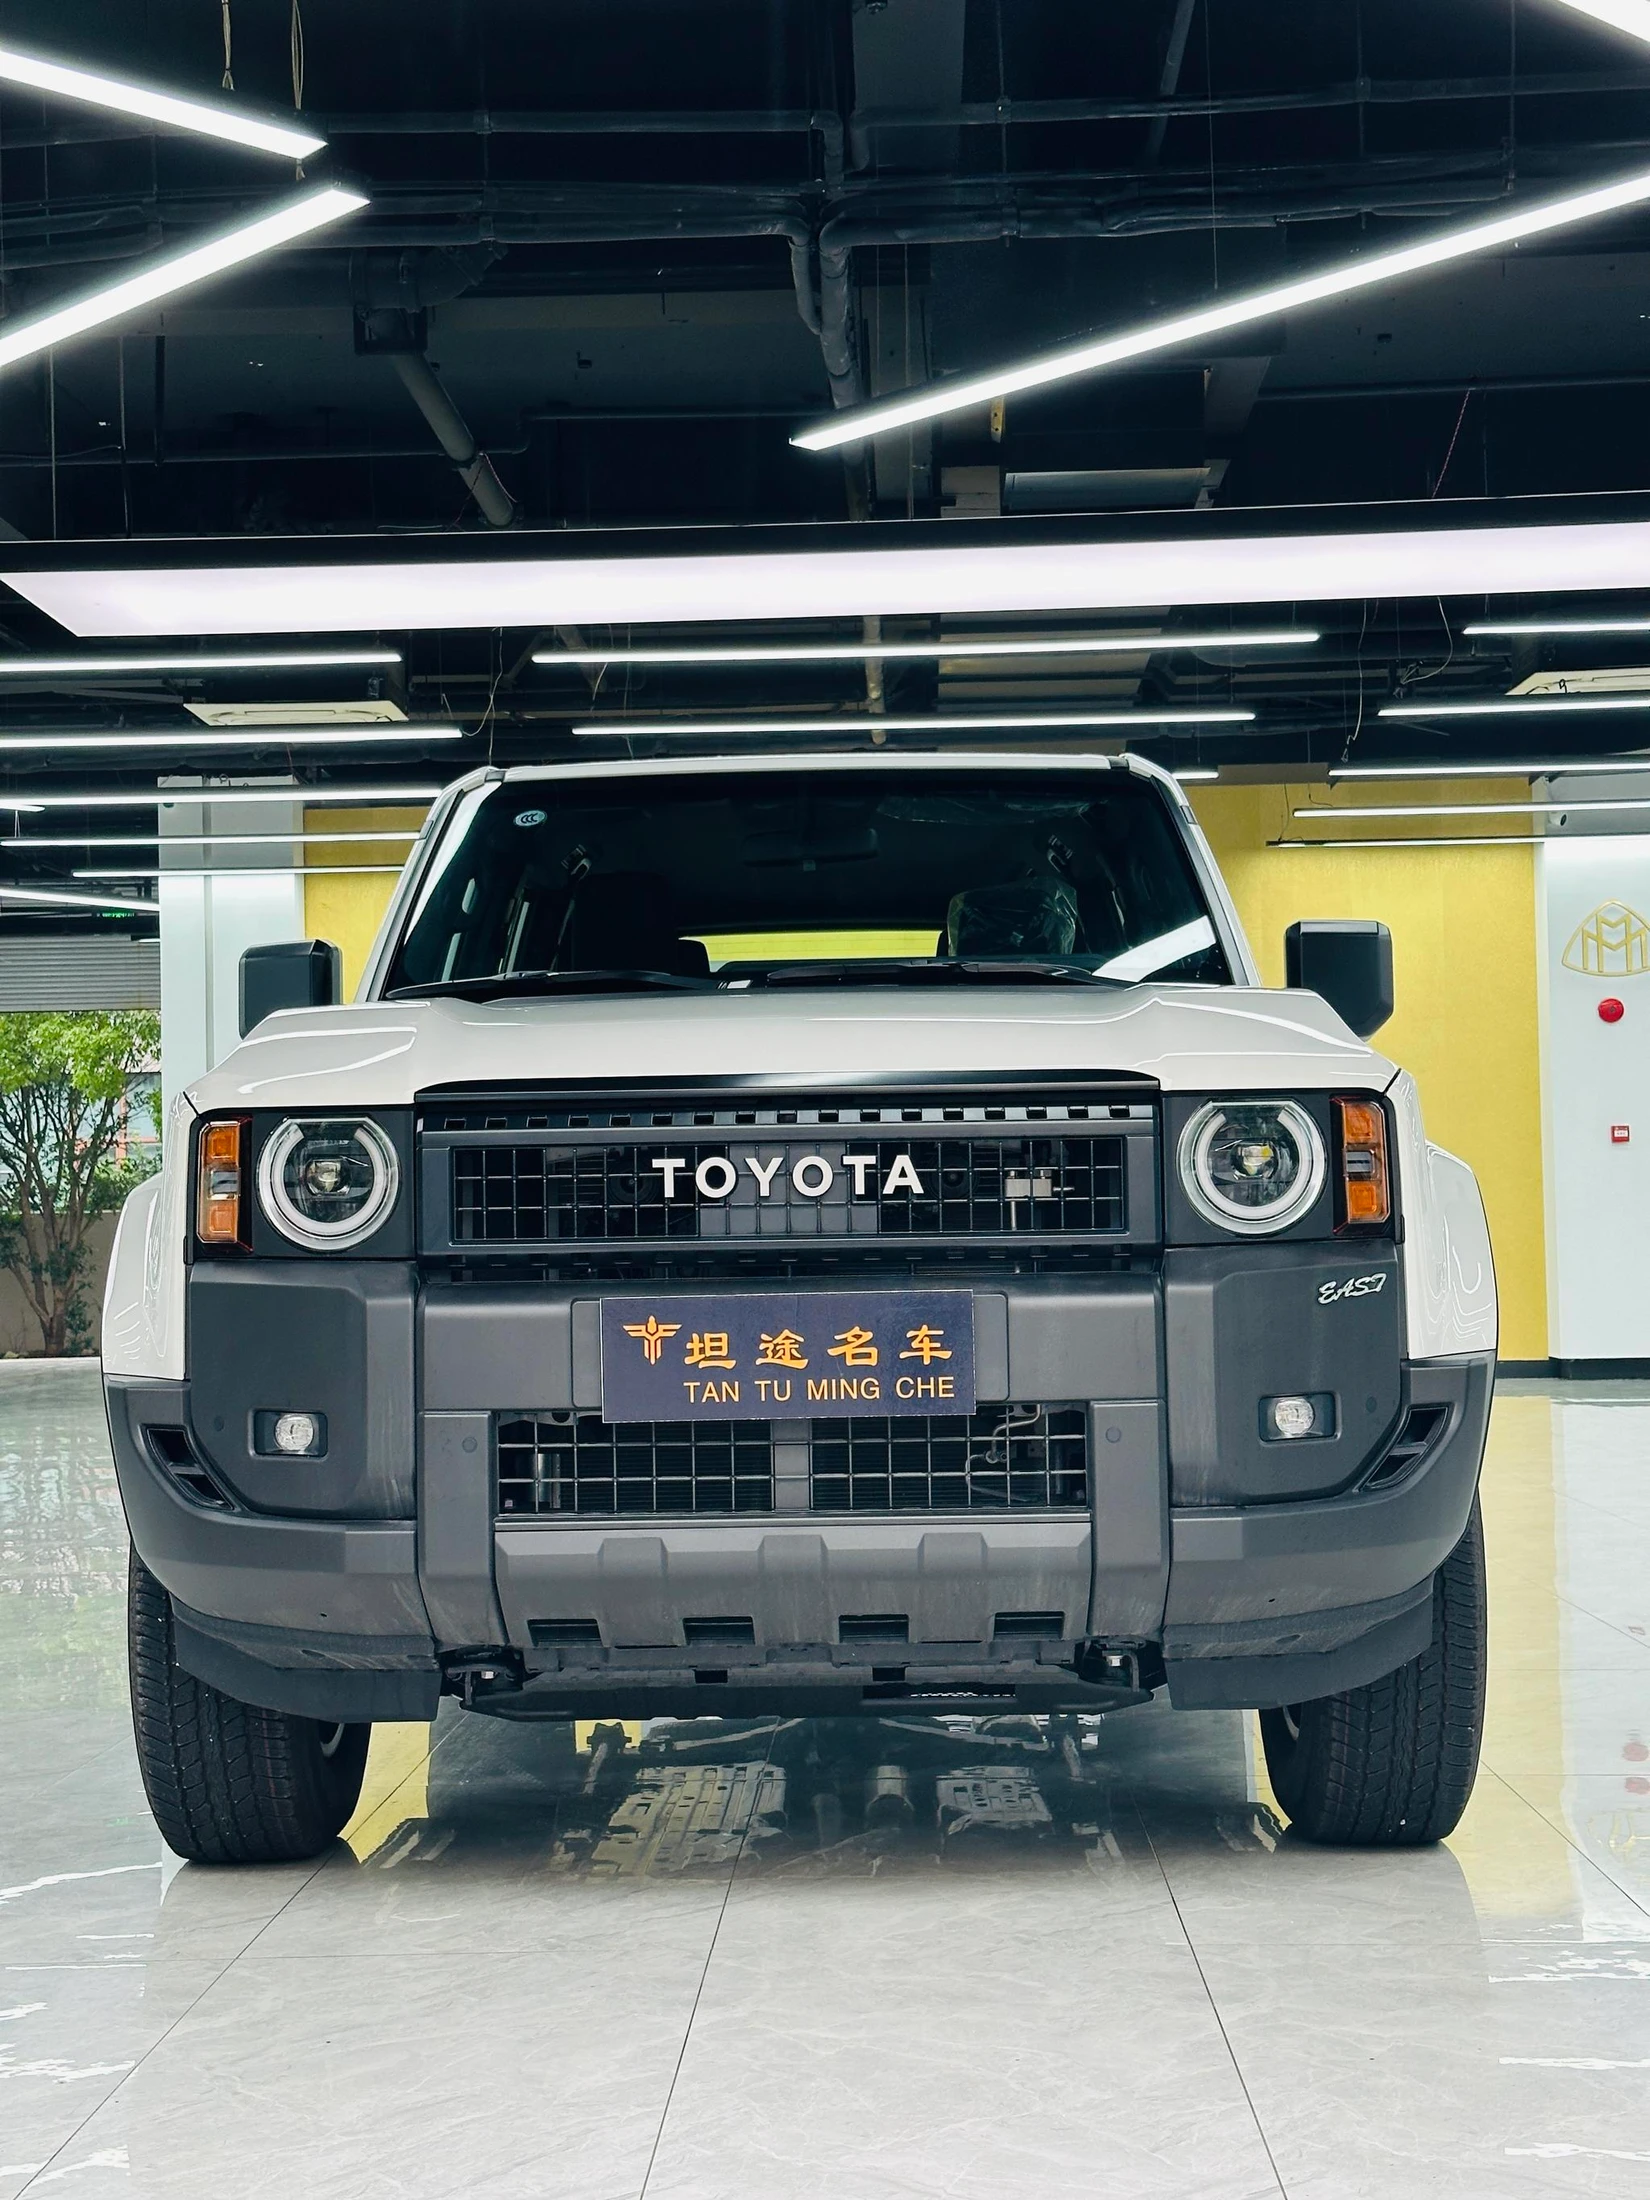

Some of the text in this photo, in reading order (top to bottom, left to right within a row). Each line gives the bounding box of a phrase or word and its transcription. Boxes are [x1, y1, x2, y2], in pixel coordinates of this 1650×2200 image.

[651, 1154, 925, 1199] TOYOTA
[684, 1324, 953, 1370] 坦途名车
[683, 1375, 955, 1403] TAN TU MING CHE
